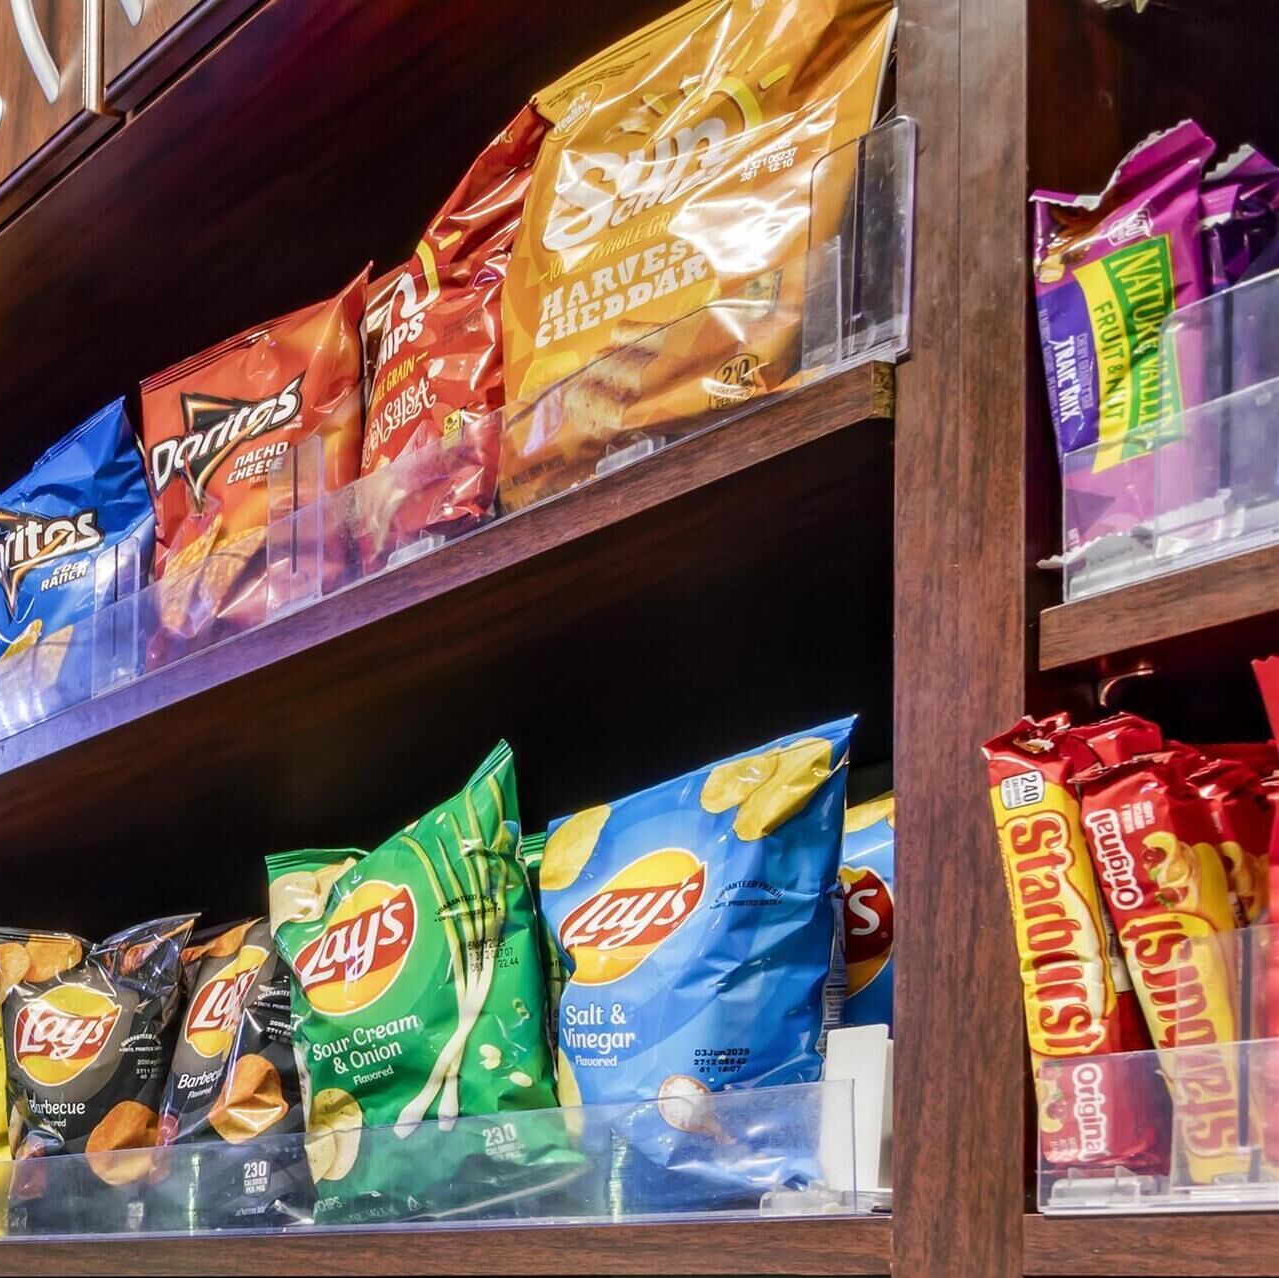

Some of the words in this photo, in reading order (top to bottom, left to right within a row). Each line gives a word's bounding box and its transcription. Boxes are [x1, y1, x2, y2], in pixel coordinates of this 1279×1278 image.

[534, 254, 711, 349] CHEDDAR
[1110, 246, 1165, 348] NATURE
[1093, 300, 1124, 361] FRUIT
[1106, 361, 1124, 375] &
[1105, 377, 1125, 421] NUT
[151, 378, 300, 491] Doritos
[234, 440, 289, 466] NACHO
[226, 455, 284, 486] CHEESE
[40, 564, 88, 592] RANCH
[1020, 774, 1040, 803] 240
[1086, 808, 1143, 911] Original
[562, 881, 693, 950] Lay's
[294, 901, 407, 989] Lay's
[1009, 815, 1104, 1053] Starburst
[565, 1004, 606, 1026] Salt
[610, 1007, 628, 1025] &
[19, 1006, 106, 1060] Lay's
[312, 1034, 352, 1062] Sour
[354, 1012, 420, 1046] Cream
[562, 1027, 636, 1051] Vinegar
[1122, 913, 1240, 1158] Starburst
[333, 1056, 349, 1074] &
[349, 1041, 403, 1070] Onion
[575, 1054, 618, 1068] Flavored
[352, 1065, 395, 1087] Flavored
[28, 1099, 86, 1116] Barbecue
[481, 1123, 518, 1147] 230
[243, 1160, 268, 1179] 230
